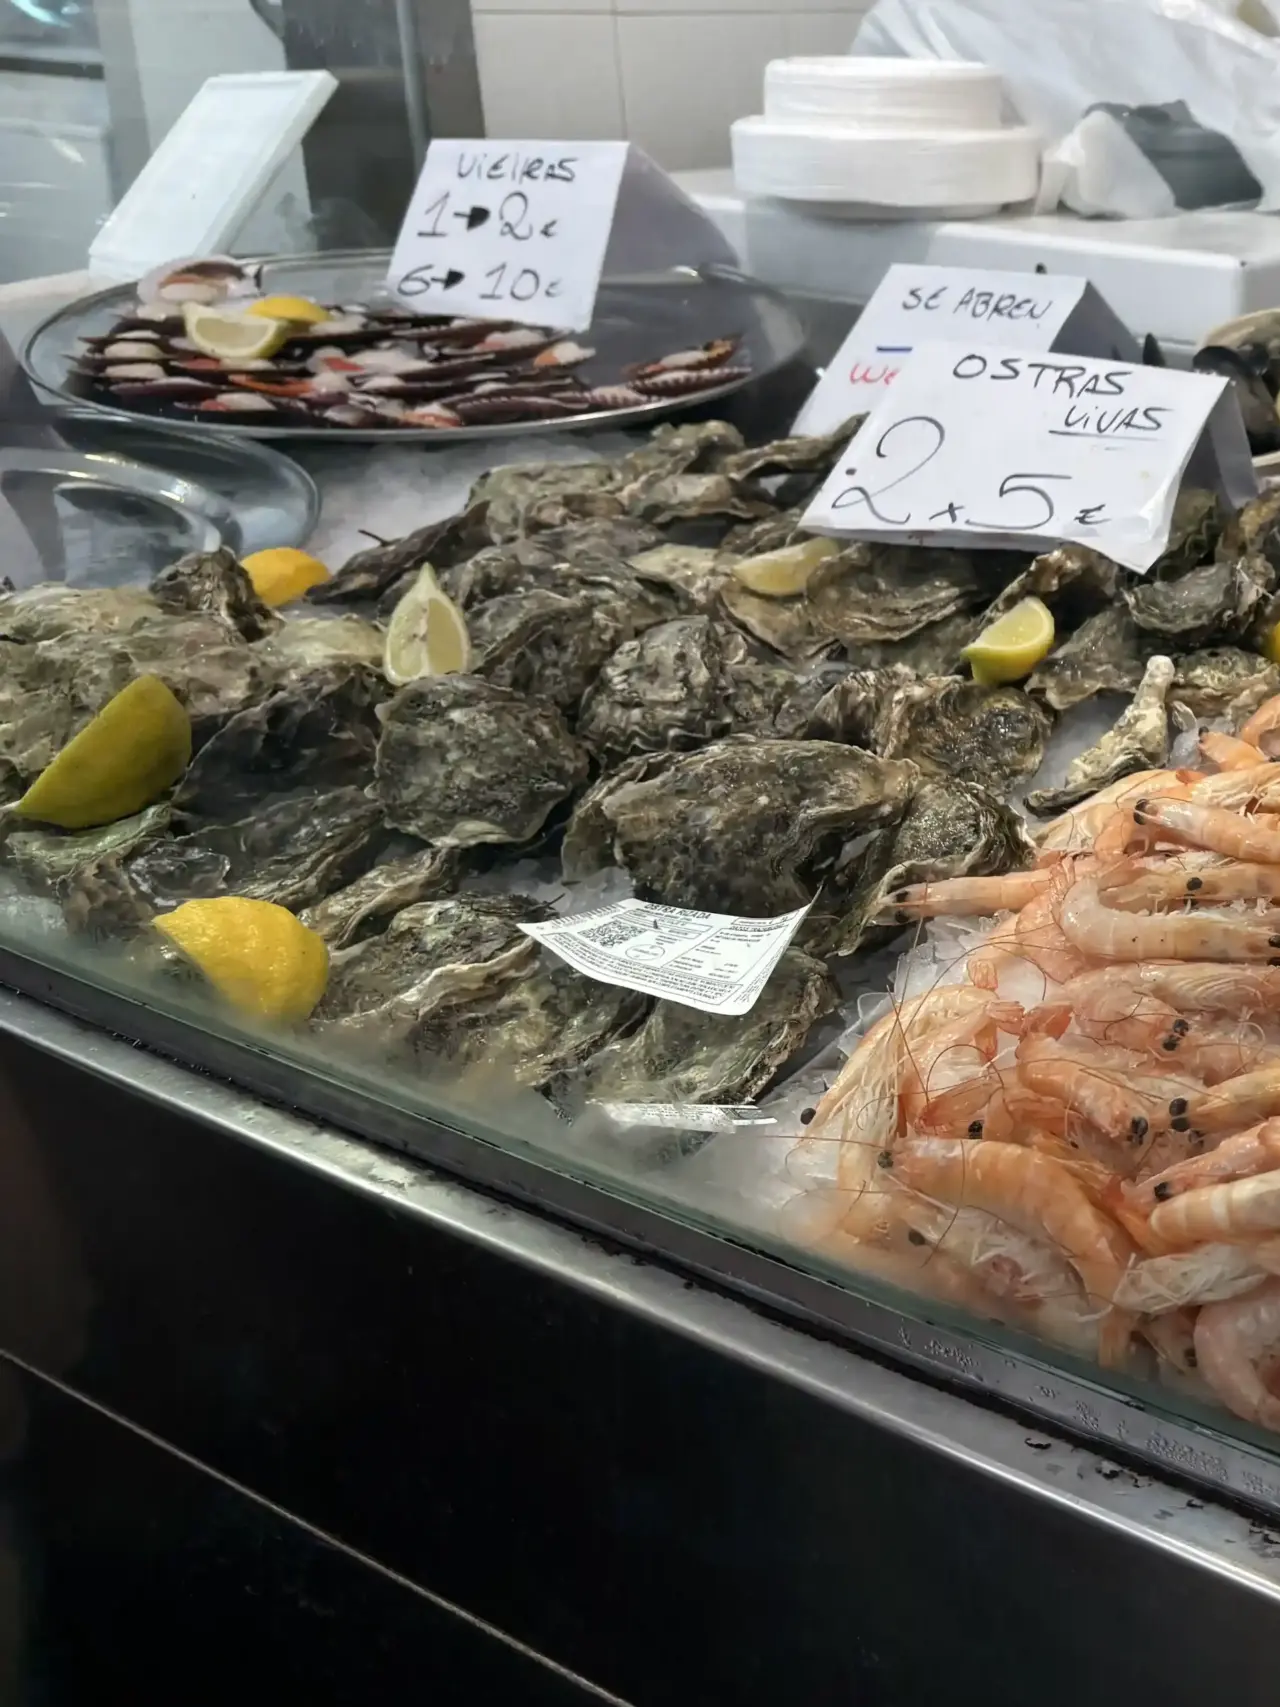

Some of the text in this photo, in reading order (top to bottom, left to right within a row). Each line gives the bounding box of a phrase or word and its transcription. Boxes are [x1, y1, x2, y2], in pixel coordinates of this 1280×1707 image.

[457, 151, 578, 182] VIEIRAS
[417, 191, 450, 237] 1
[397, 264, 435, 296] 6
[902, 286, 1053, 321] SE ABREN
[952, 352, 1134, 399] OSTRAS
[1064, 403, 1174, 433] VIVAS
[831, 416, 945, 524] 2
[964, 473, 1072, 530] 5
